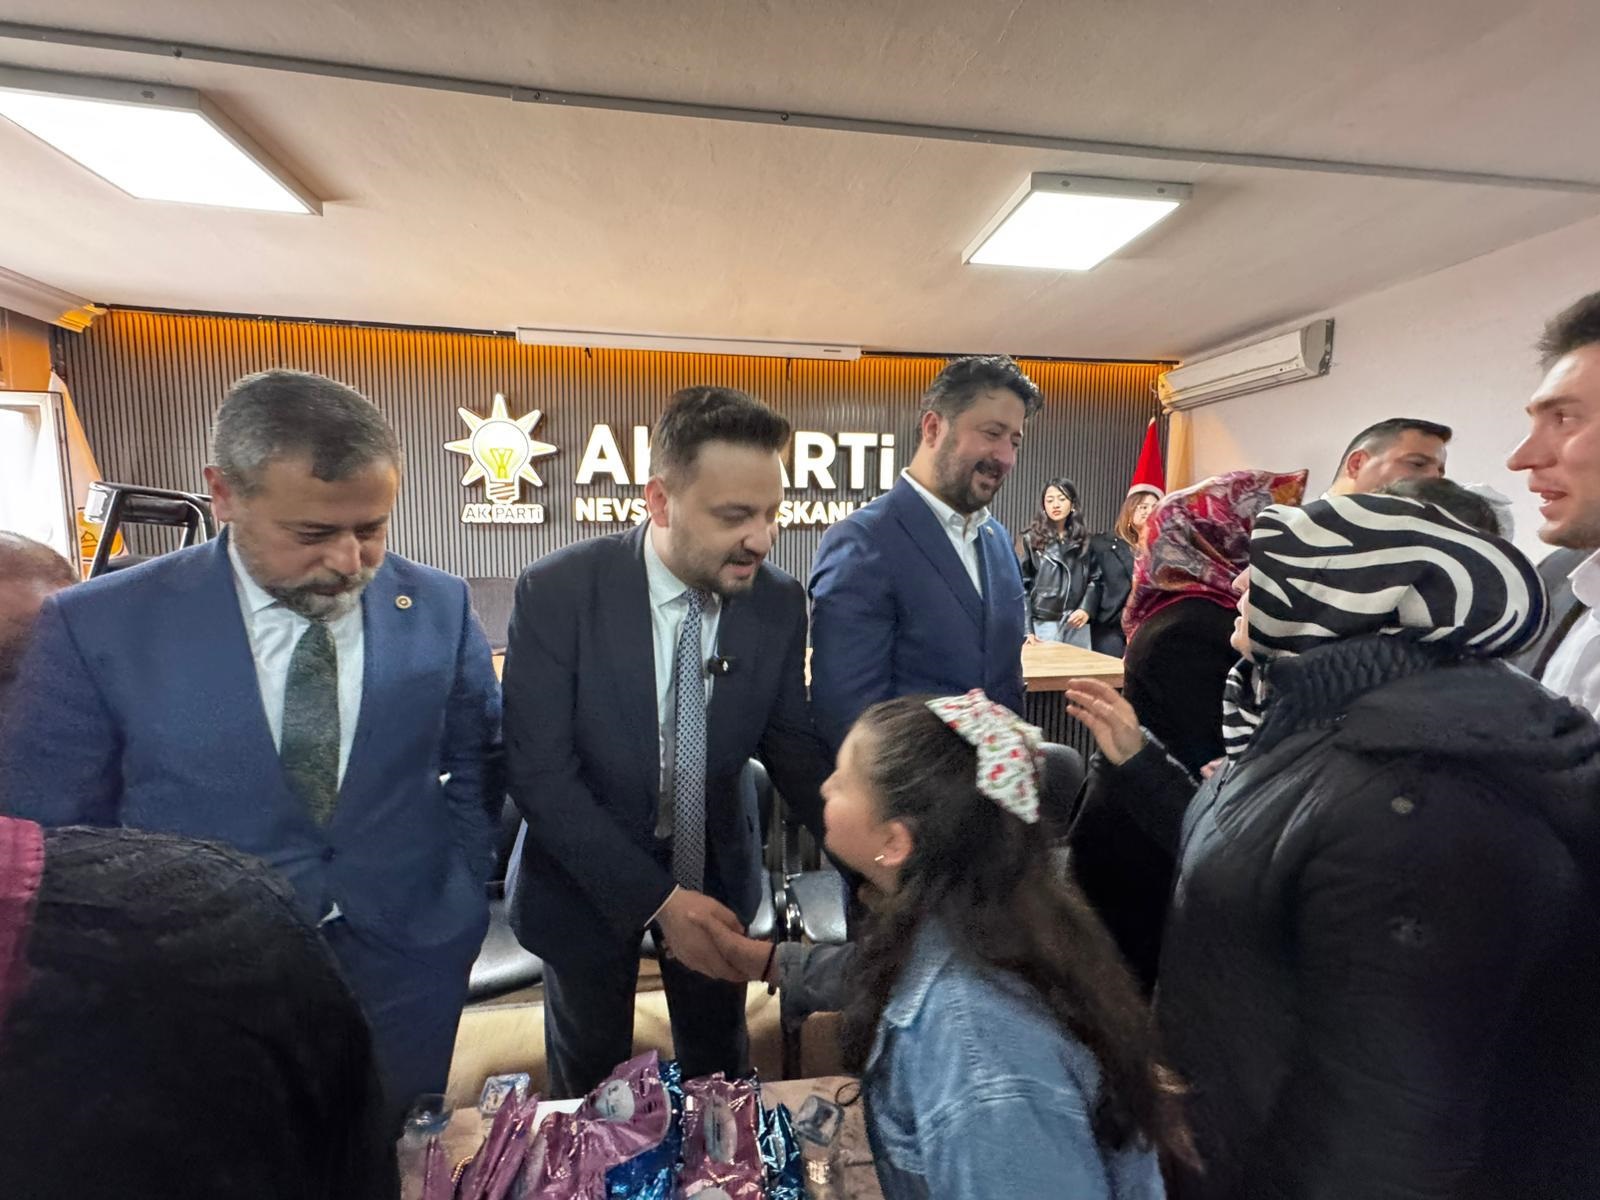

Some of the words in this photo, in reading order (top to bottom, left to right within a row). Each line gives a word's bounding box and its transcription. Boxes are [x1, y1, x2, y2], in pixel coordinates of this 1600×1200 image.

[779, 430, 895, 490] RTi
[464, 505, 490, 521] AK
[575, 497, 649, 526] NEVŞ
